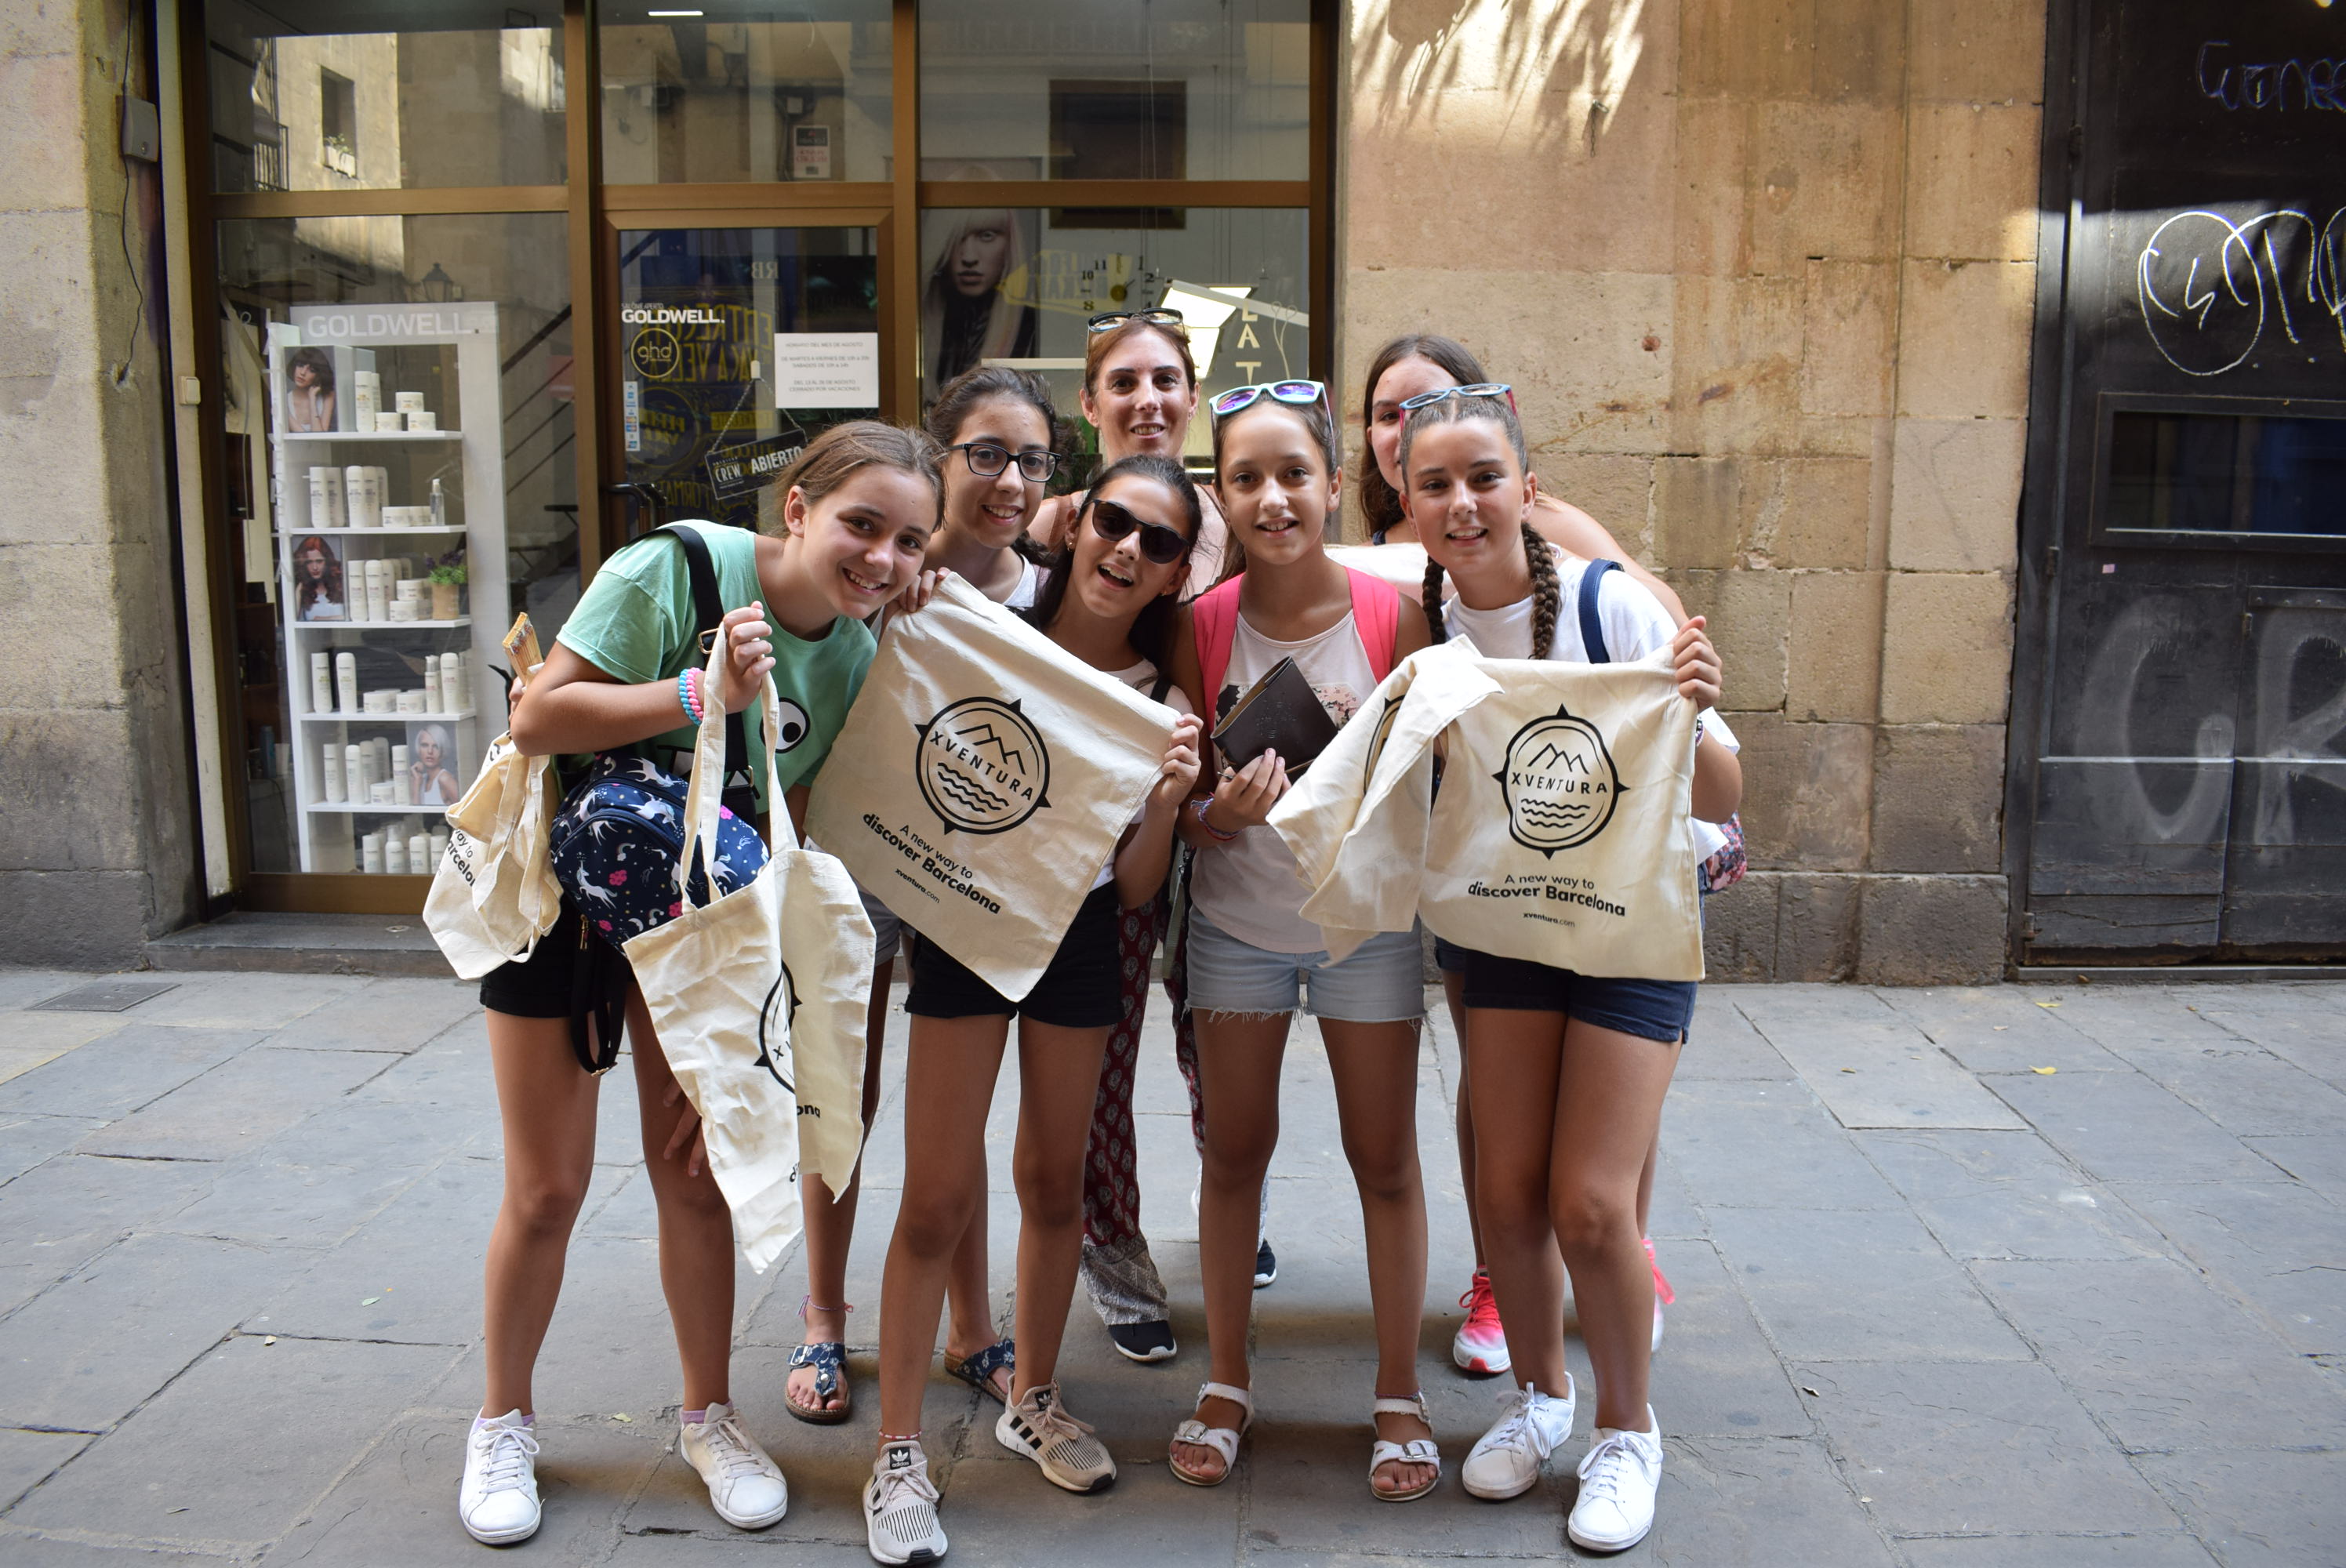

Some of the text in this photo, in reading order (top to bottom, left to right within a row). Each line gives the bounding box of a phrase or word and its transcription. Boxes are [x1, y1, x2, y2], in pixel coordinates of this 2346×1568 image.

[637, 340, 672, 365] ghd
[715, 463, 742, 483] CREW
[929, 731, 1033, 801] XVENTURA
[1512, 772, 1607, 794] XVENTURA
[863, 812, 1001, 915] discover Barcelona
[899, 824, 973, 879] A new way to
[895, 868, 941, 904] xventura.com
[1505, 874, 1595, 890] A new way to
[1468, 881, 1625, 916] discover Barcelona
[1523, 912, 1575, 928] xventura.com
